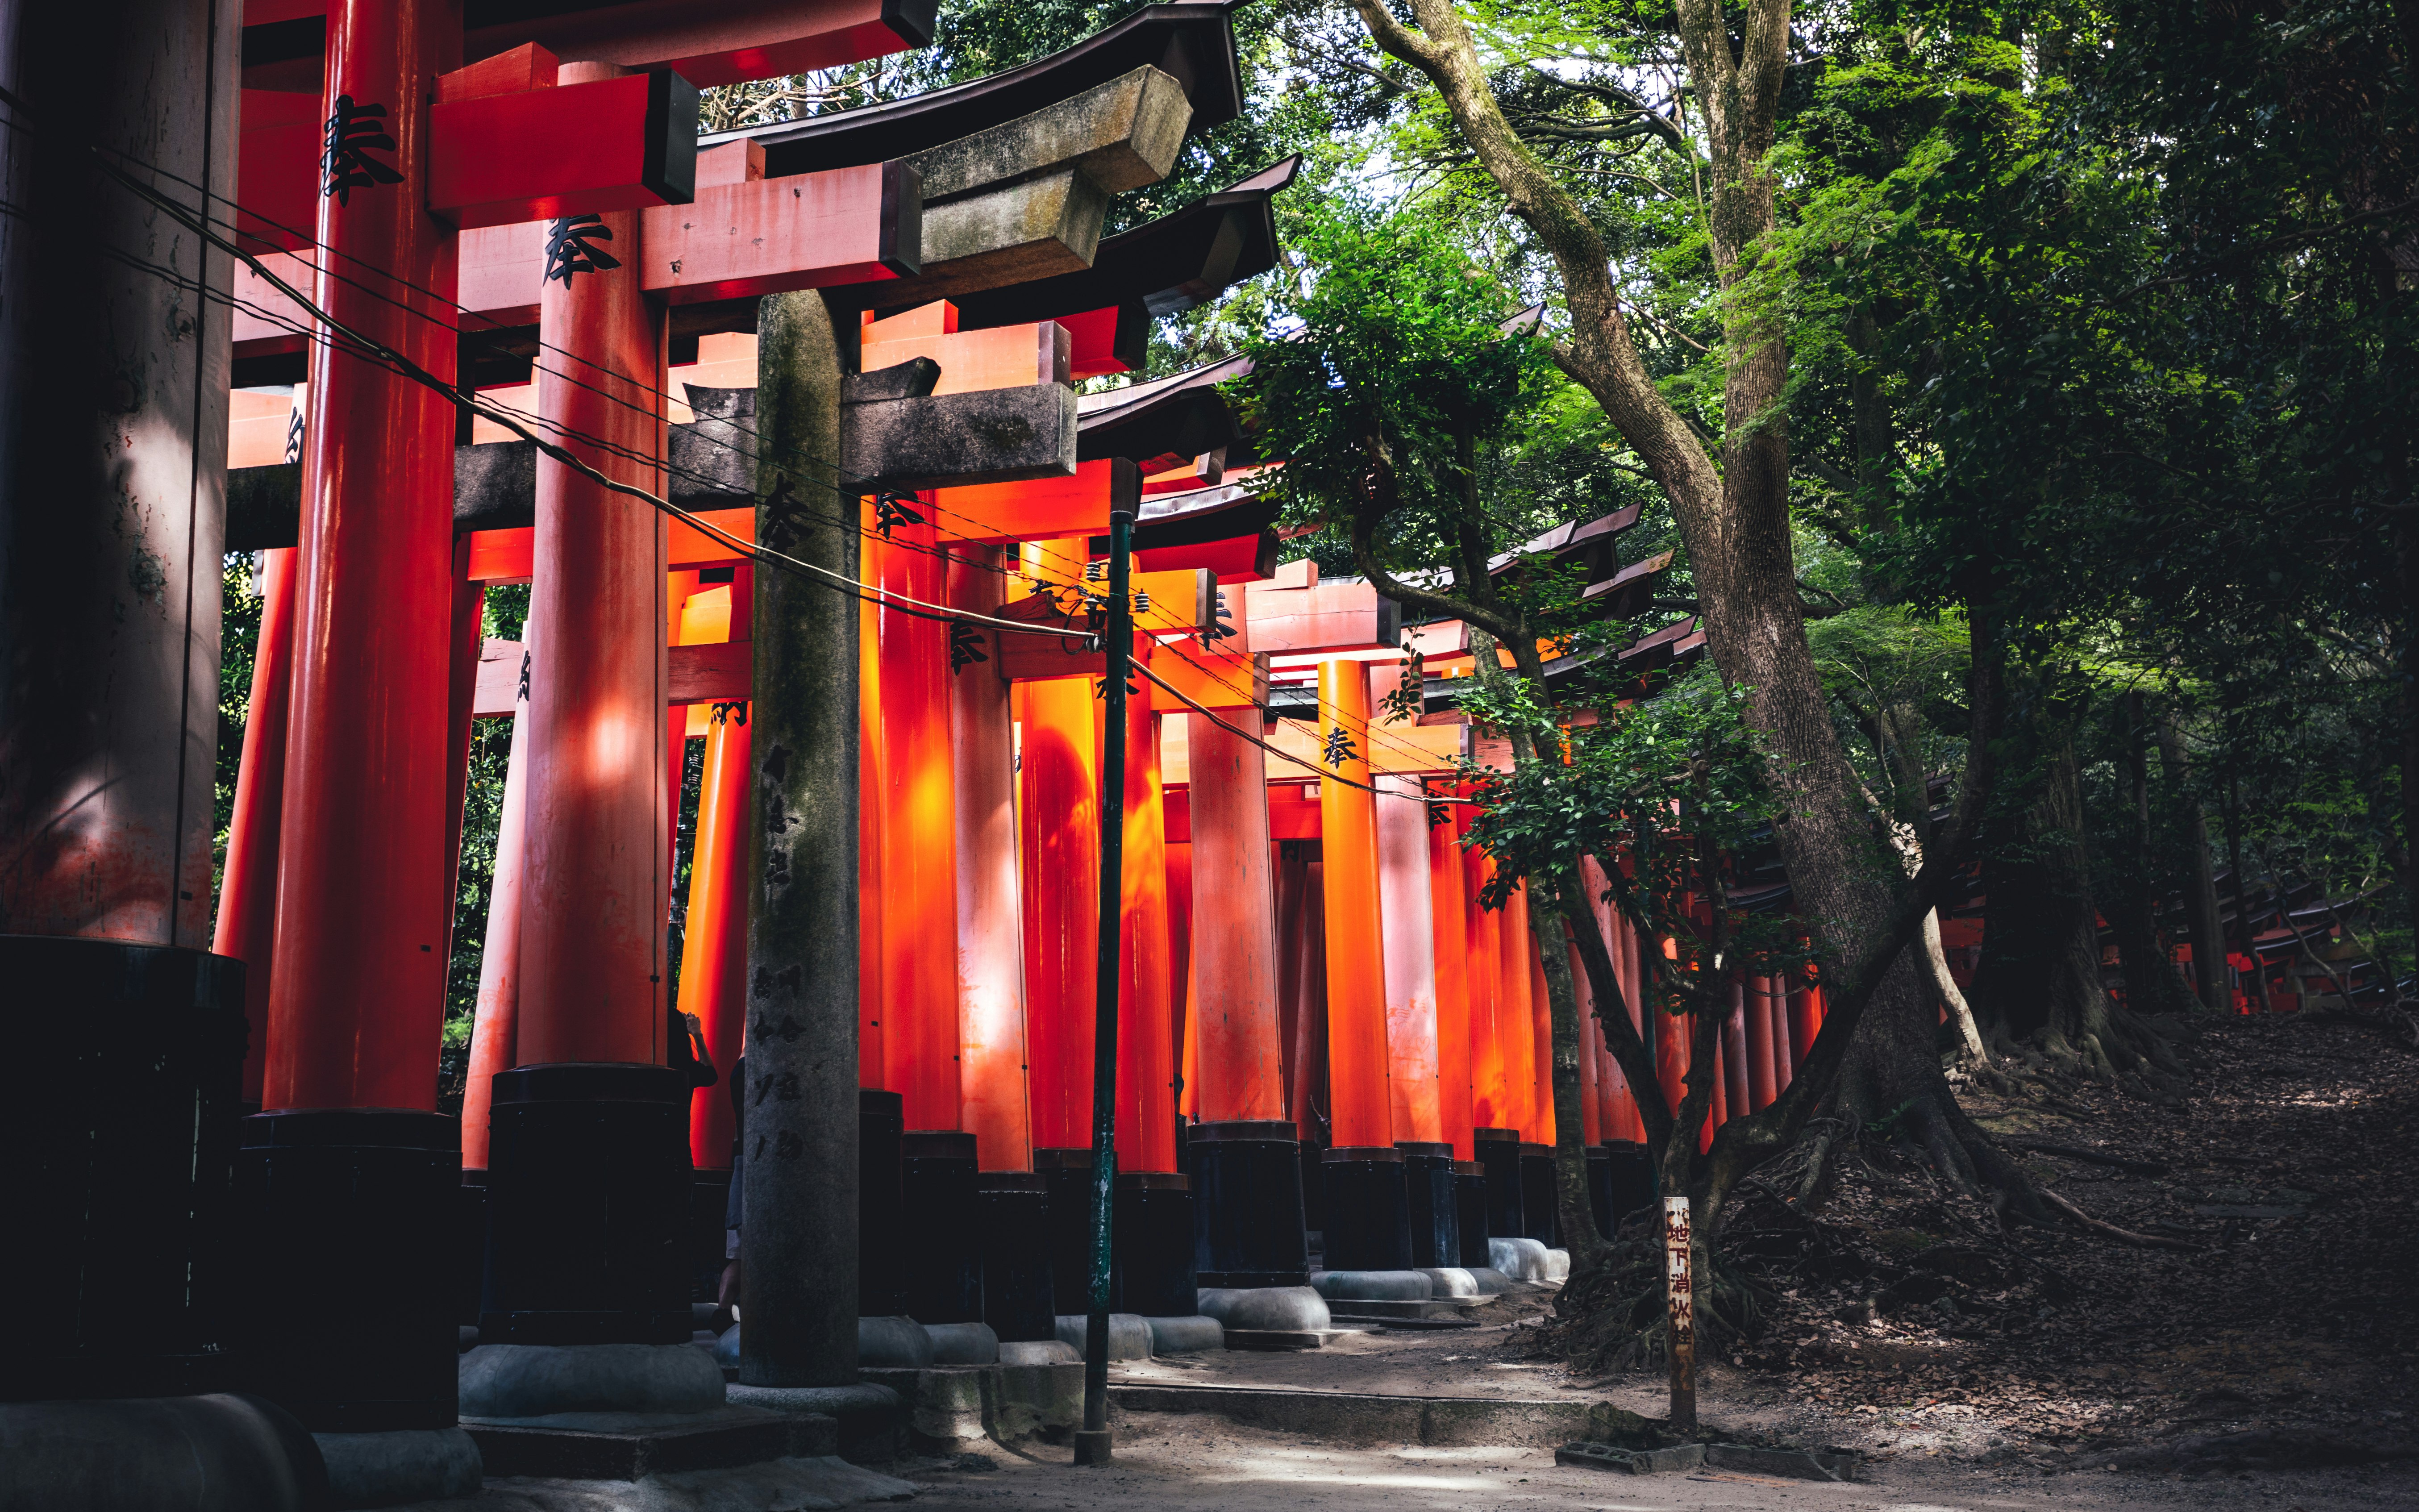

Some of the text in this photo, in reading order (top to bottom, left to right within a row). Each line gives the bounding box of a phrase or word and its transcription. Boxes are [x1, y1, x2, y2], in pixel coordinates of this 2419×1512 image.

[318, 95, 405, 208] 奉
[1324, 727, 1356, 768] 奉
[1668, 1224, 1692, 1345] 地下消火栓
